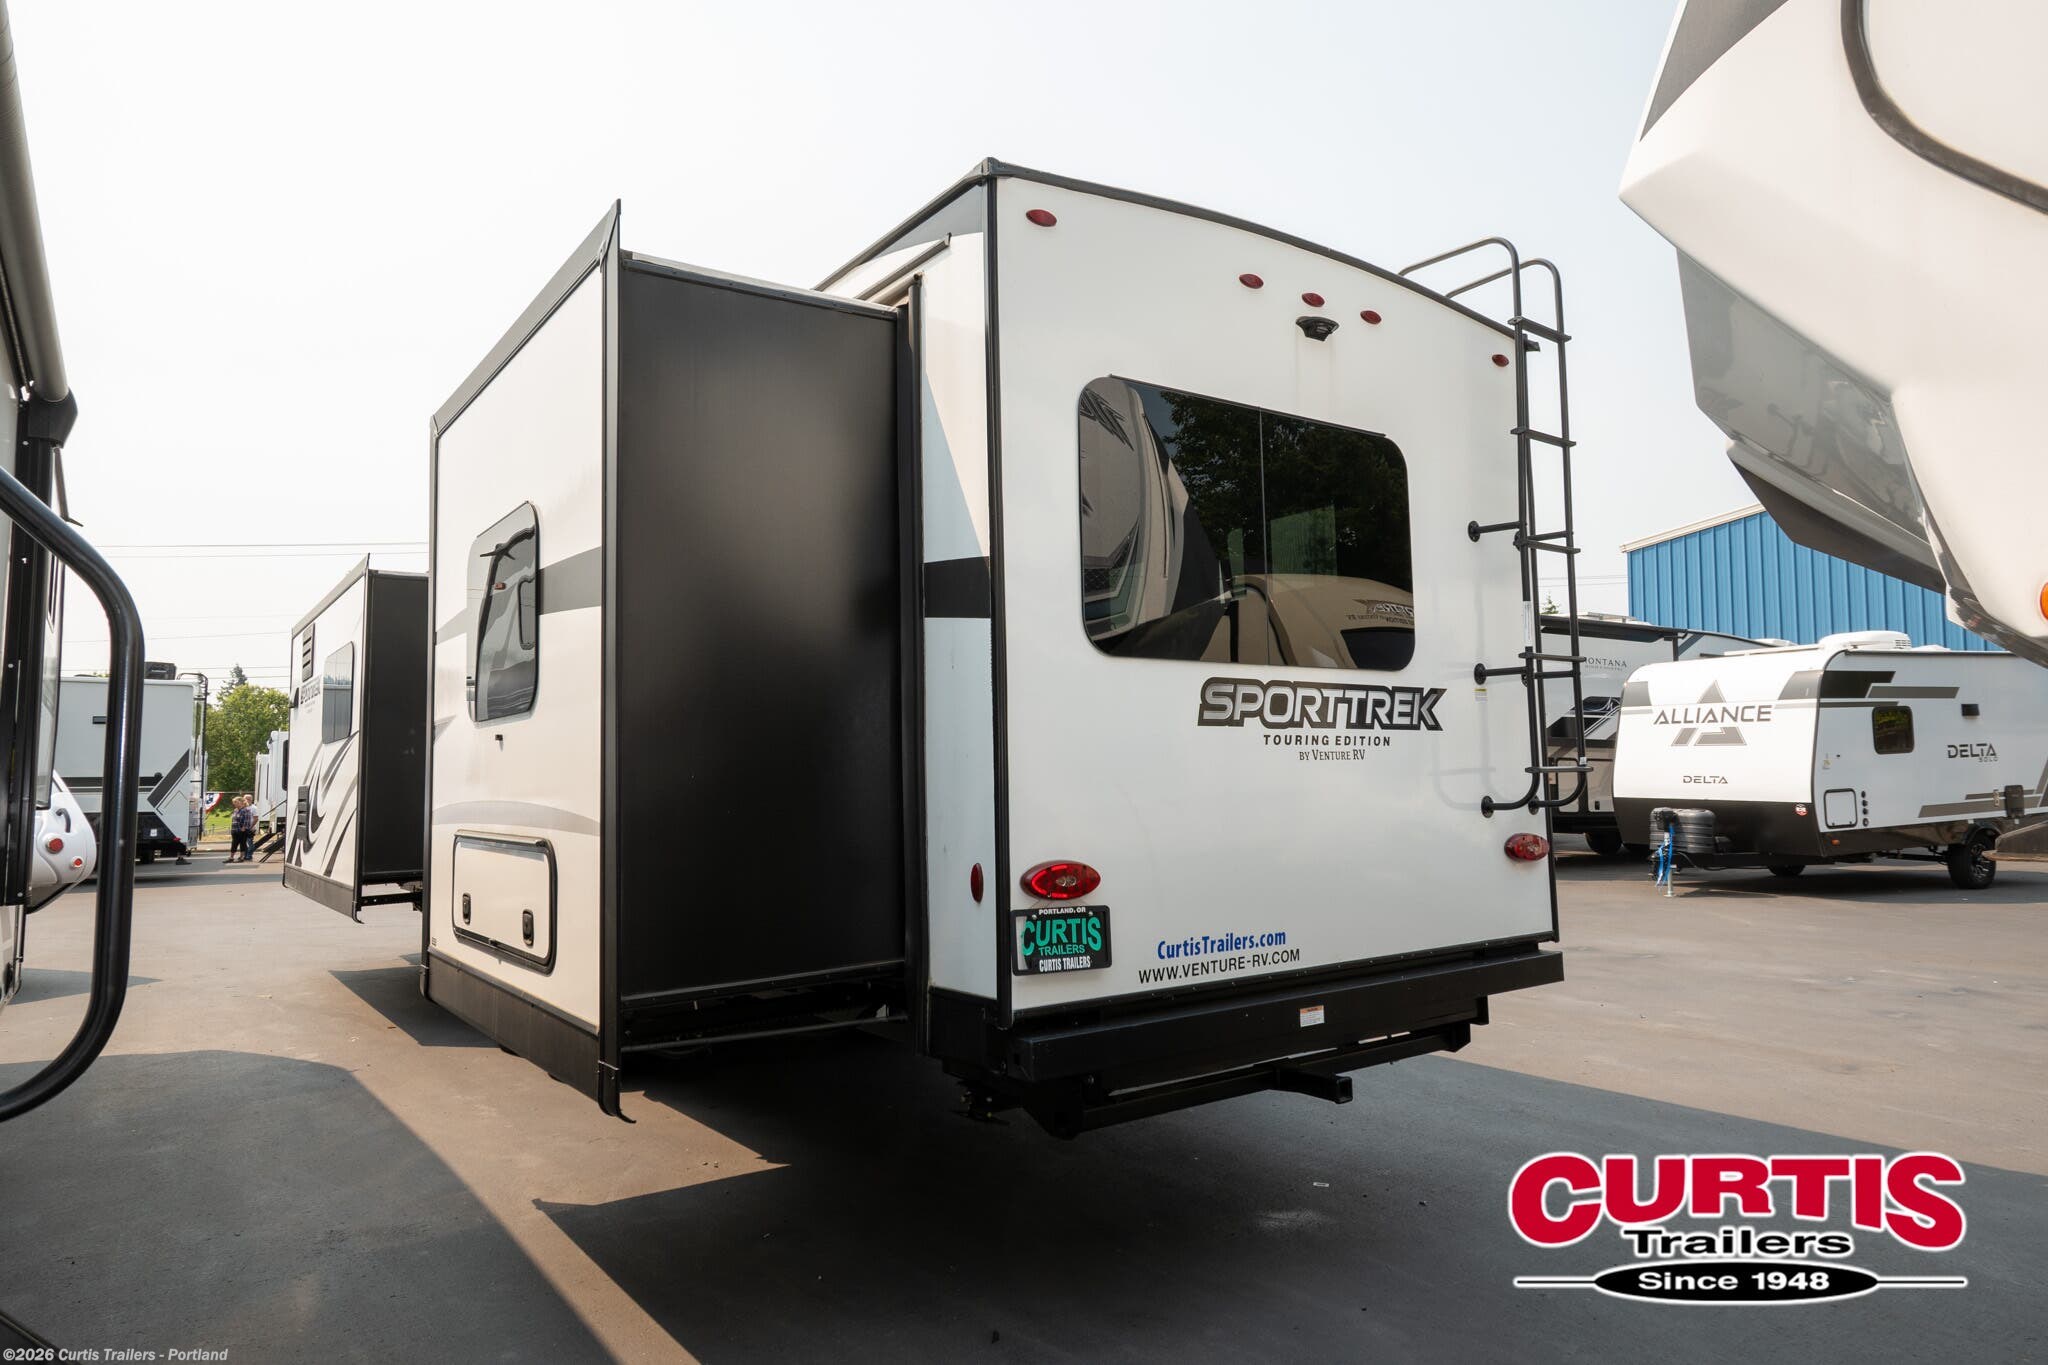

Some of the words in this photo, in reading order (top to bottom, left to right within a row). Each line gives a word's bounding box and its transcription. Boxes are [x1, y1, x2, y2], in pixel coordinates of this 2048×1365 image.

[1584, 657, 1627, 668] ONTANA
[1198, 677, 1447, 731] SPORTTREK
[1653, 705, 1772, 725] ALLIANCE
[1263, 734, 1330, 746] TOURING
[1335, 735, 1392, 747] EDITION
[1352, 750, 1366, 760] RV
[1947, 743, 1997, 759] DELTA
[1683, 775, 1728, 784] DELTA
[1076, 906, 1087, 914] OR
[1022, 916, 1103, 956] CURTIS
[1038, 944, 1086, 957] TRAILERS
[1157, 931, 1286, 960] CurtisTrailers.com
[1039, 958, 1062, 973] CURTIS
[1063, 955, 1091, 971] TRAILERS
[1138, 948, 1300, 984] WWW.VENTURE-RV.COM
